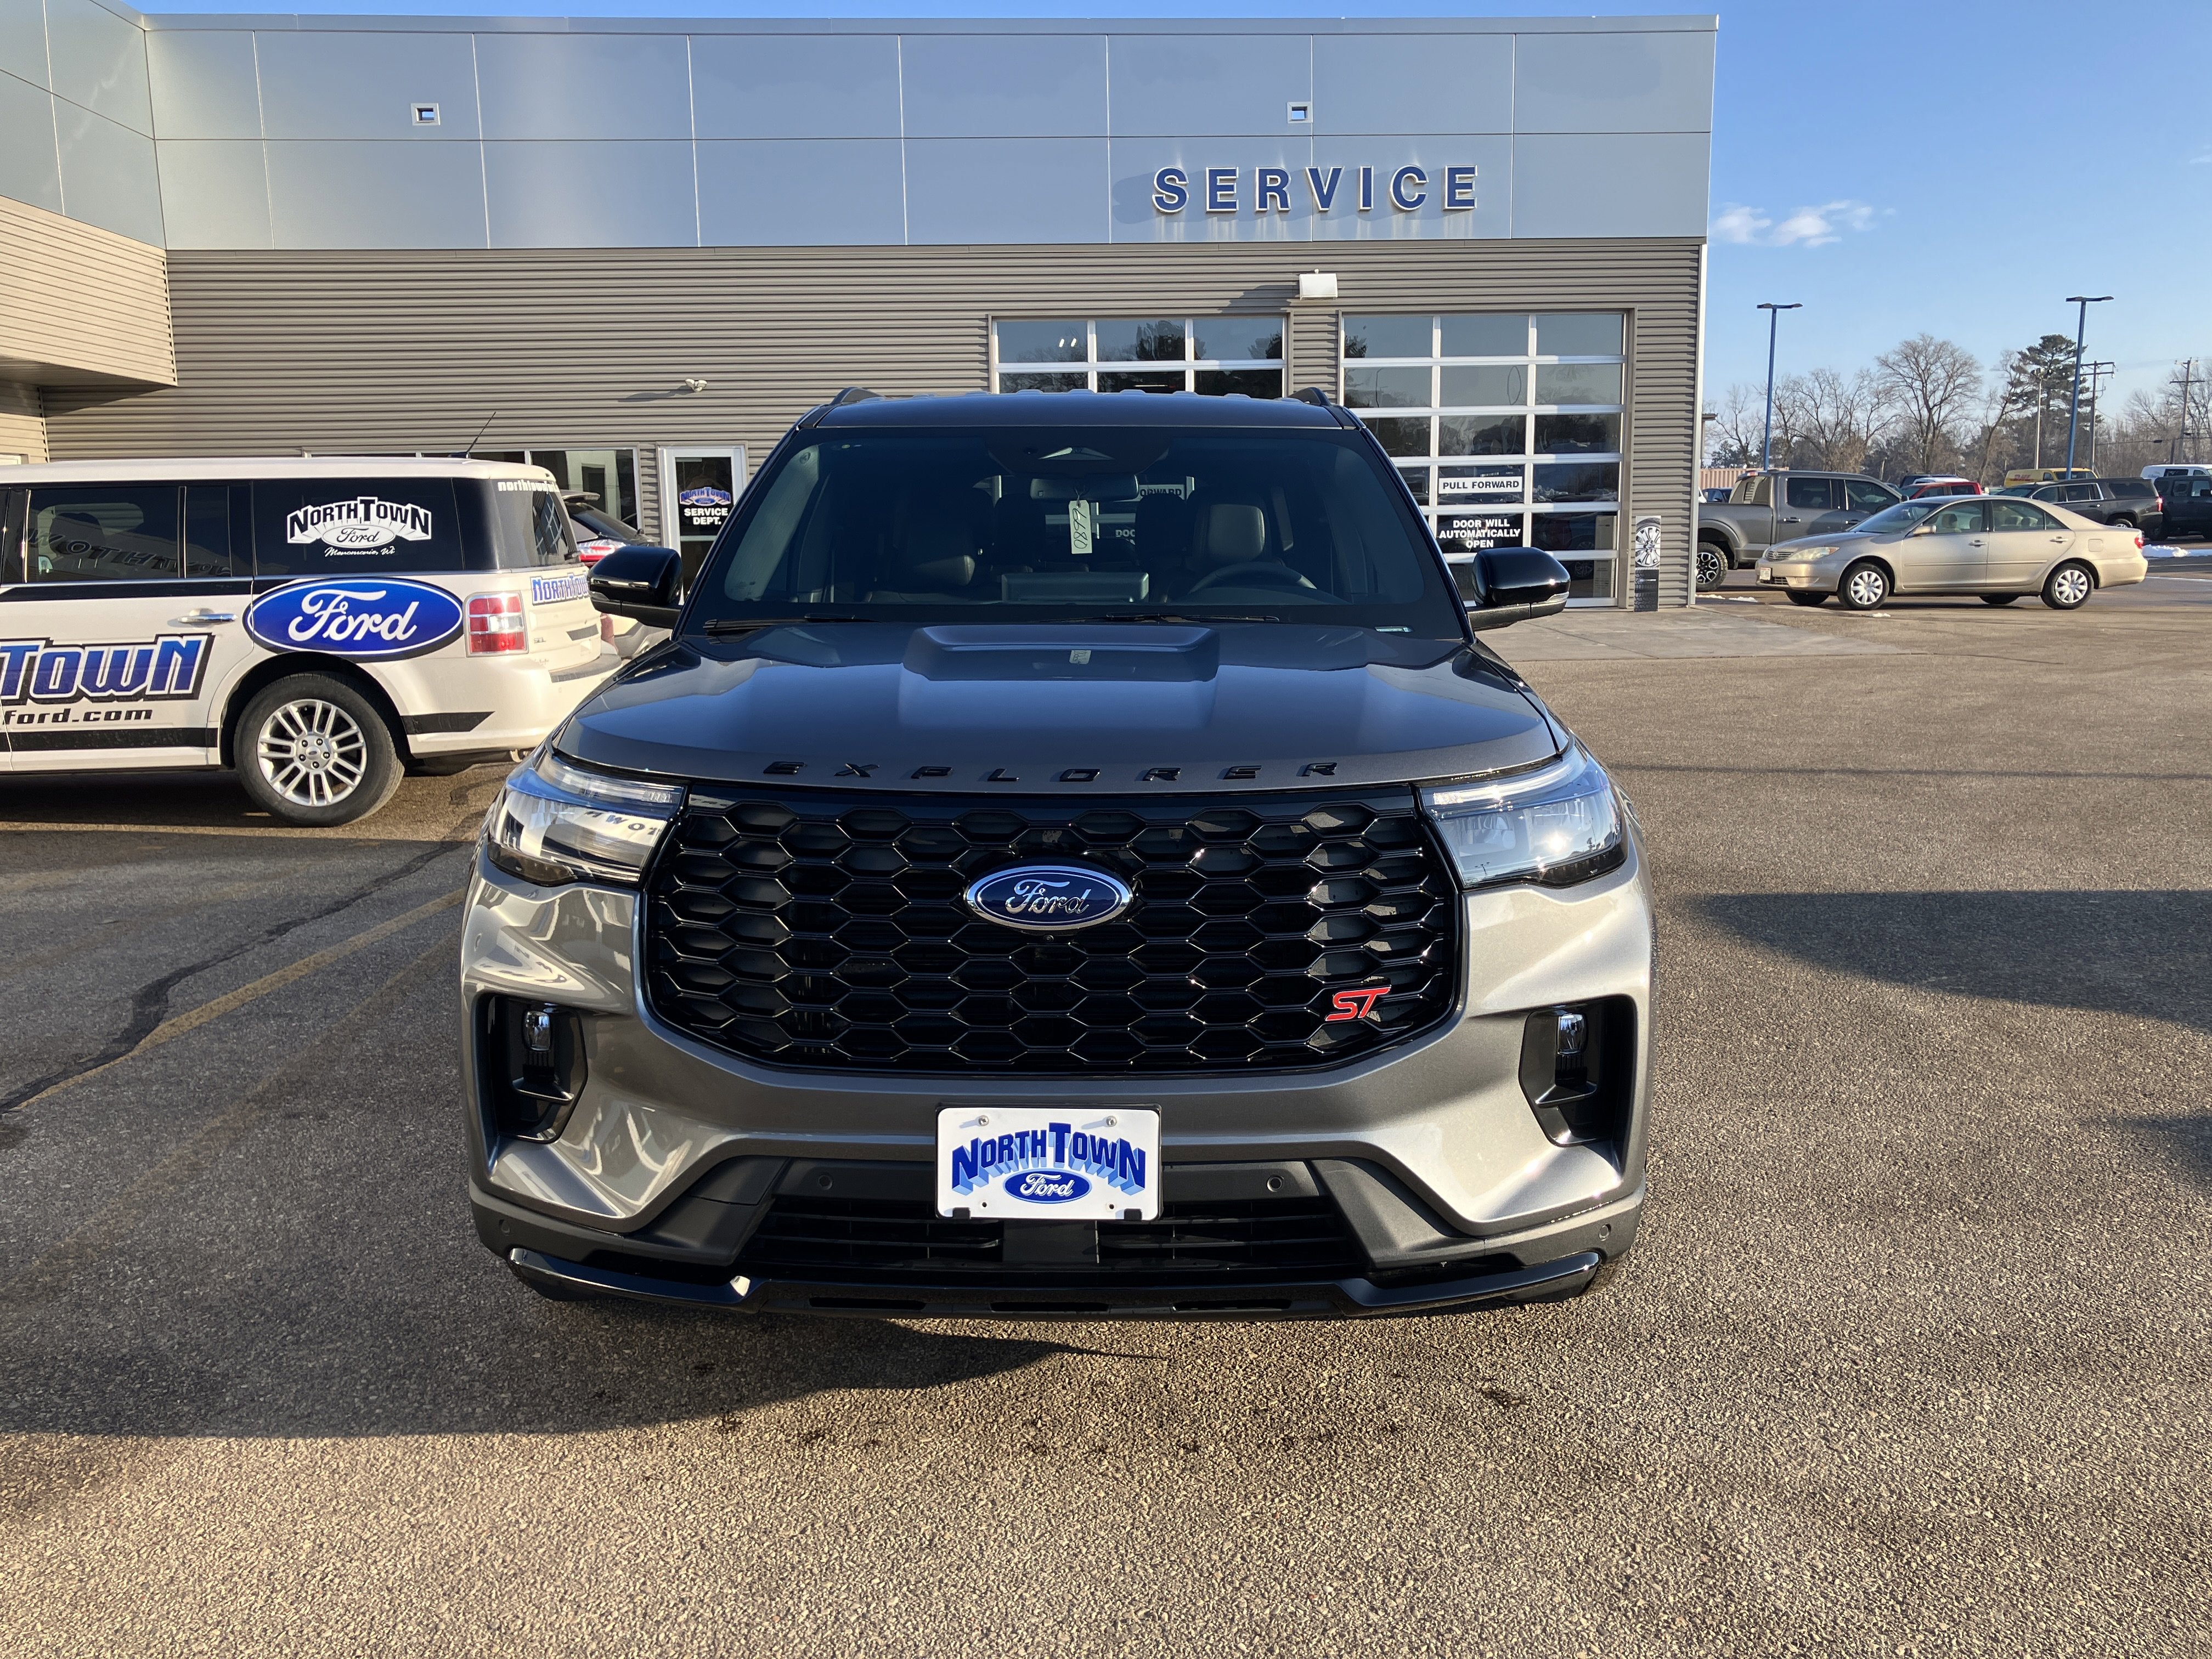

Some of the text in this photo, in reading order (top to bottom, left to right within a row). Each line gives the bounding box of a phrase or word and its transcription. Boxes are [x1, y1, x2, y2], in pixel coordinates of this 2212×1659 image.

[1152, 165, 1478, 214] SERVICE
[1443, 481, 1520, 490] PULL FORWARD
[289, 498, 430, 541] NORTHTOWN
[684, 507, 729, 517] SERVICE
[693, 517, 722, 525] DEPT.
[1439, 529, 1521, 539] AUTOMATICALLY
[1453, 519, 1510, 528] DOOR WILL
[336, 527, 380, 543] Ford
[1466, 539, 1494, 548] OPEN
[531, 574, 590, 602] NORTHTOW
[288, 589, 420, 641] Ford
[2, 708, 153, 725] ford.com
[763, 761, 1338, 782] EXPLORER
[1005, 879, 1091, 914] Ford
[1324, 987, 1391, 1021] ST
[952, 1122, 1146, 1193] NORTHTOWN
[1020, 1173, 1075, 1197] Ford
